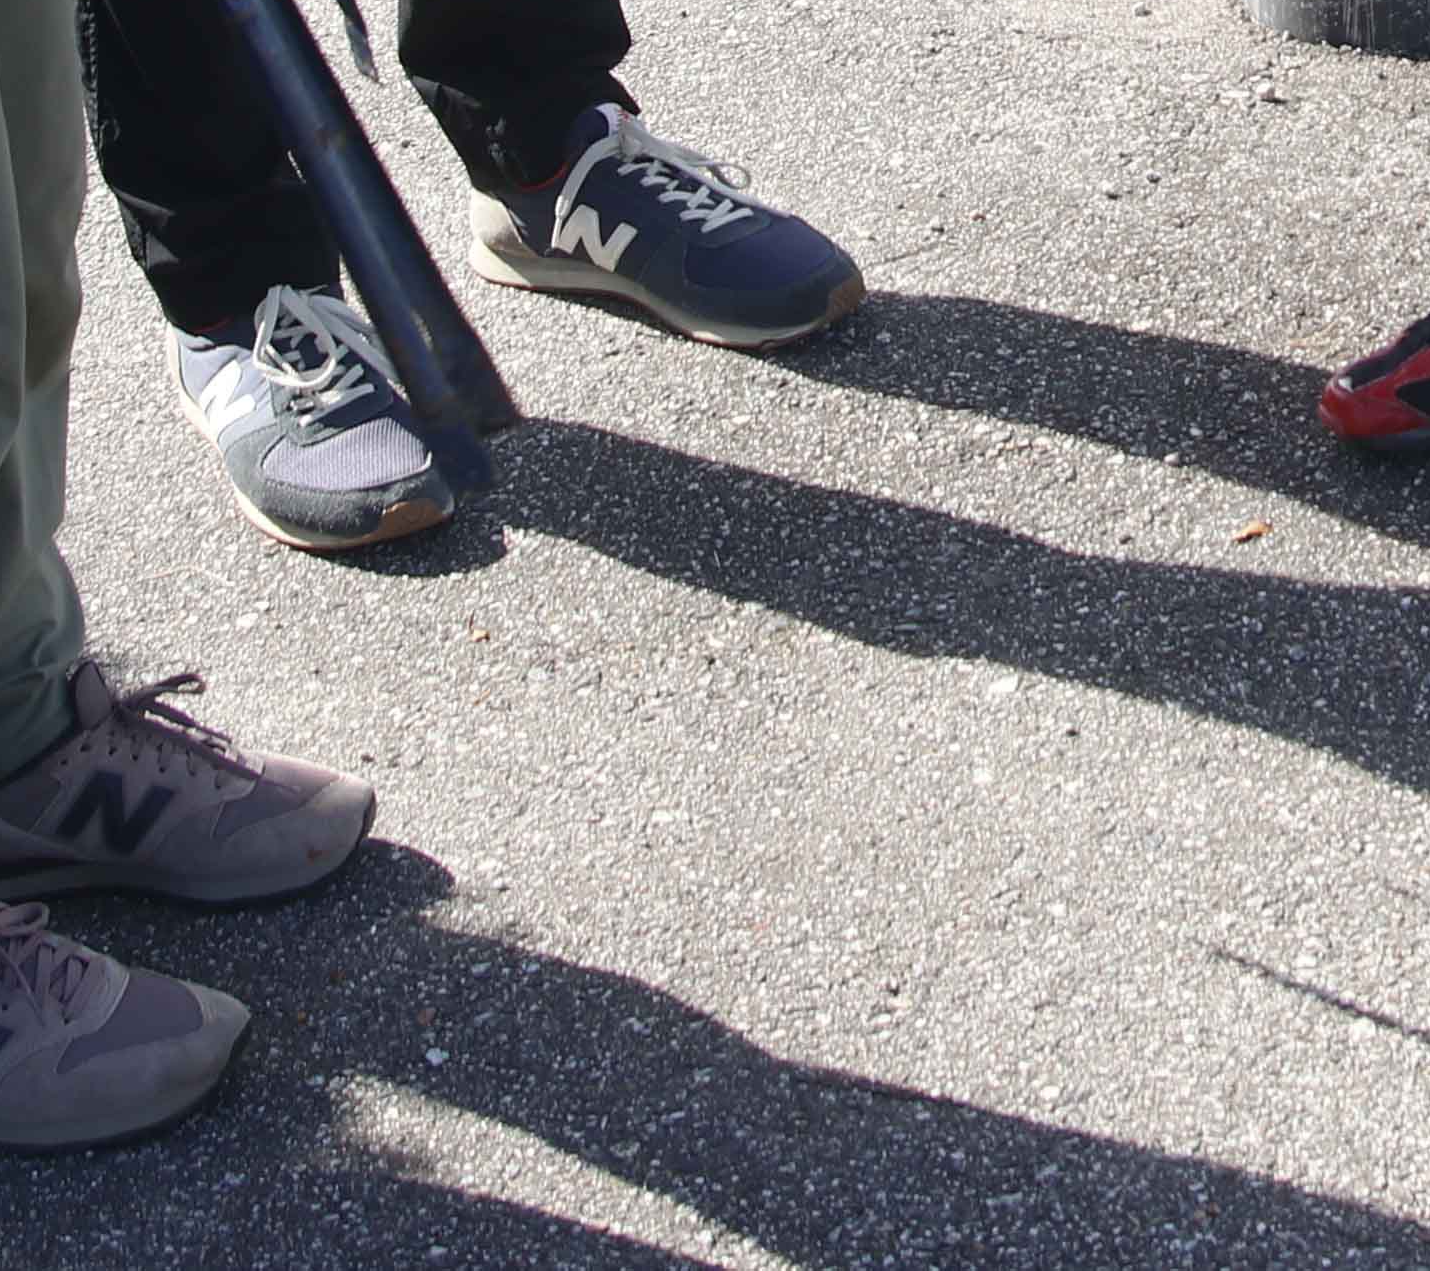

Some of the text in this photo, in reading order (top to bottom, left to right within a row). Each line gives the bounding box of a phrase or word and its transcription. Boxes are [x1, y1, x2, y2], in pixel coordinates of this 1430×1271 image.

[556, 203, 637, 273] N
[198, 359, 256, 432] N
[53, 769, 176, 857] N
